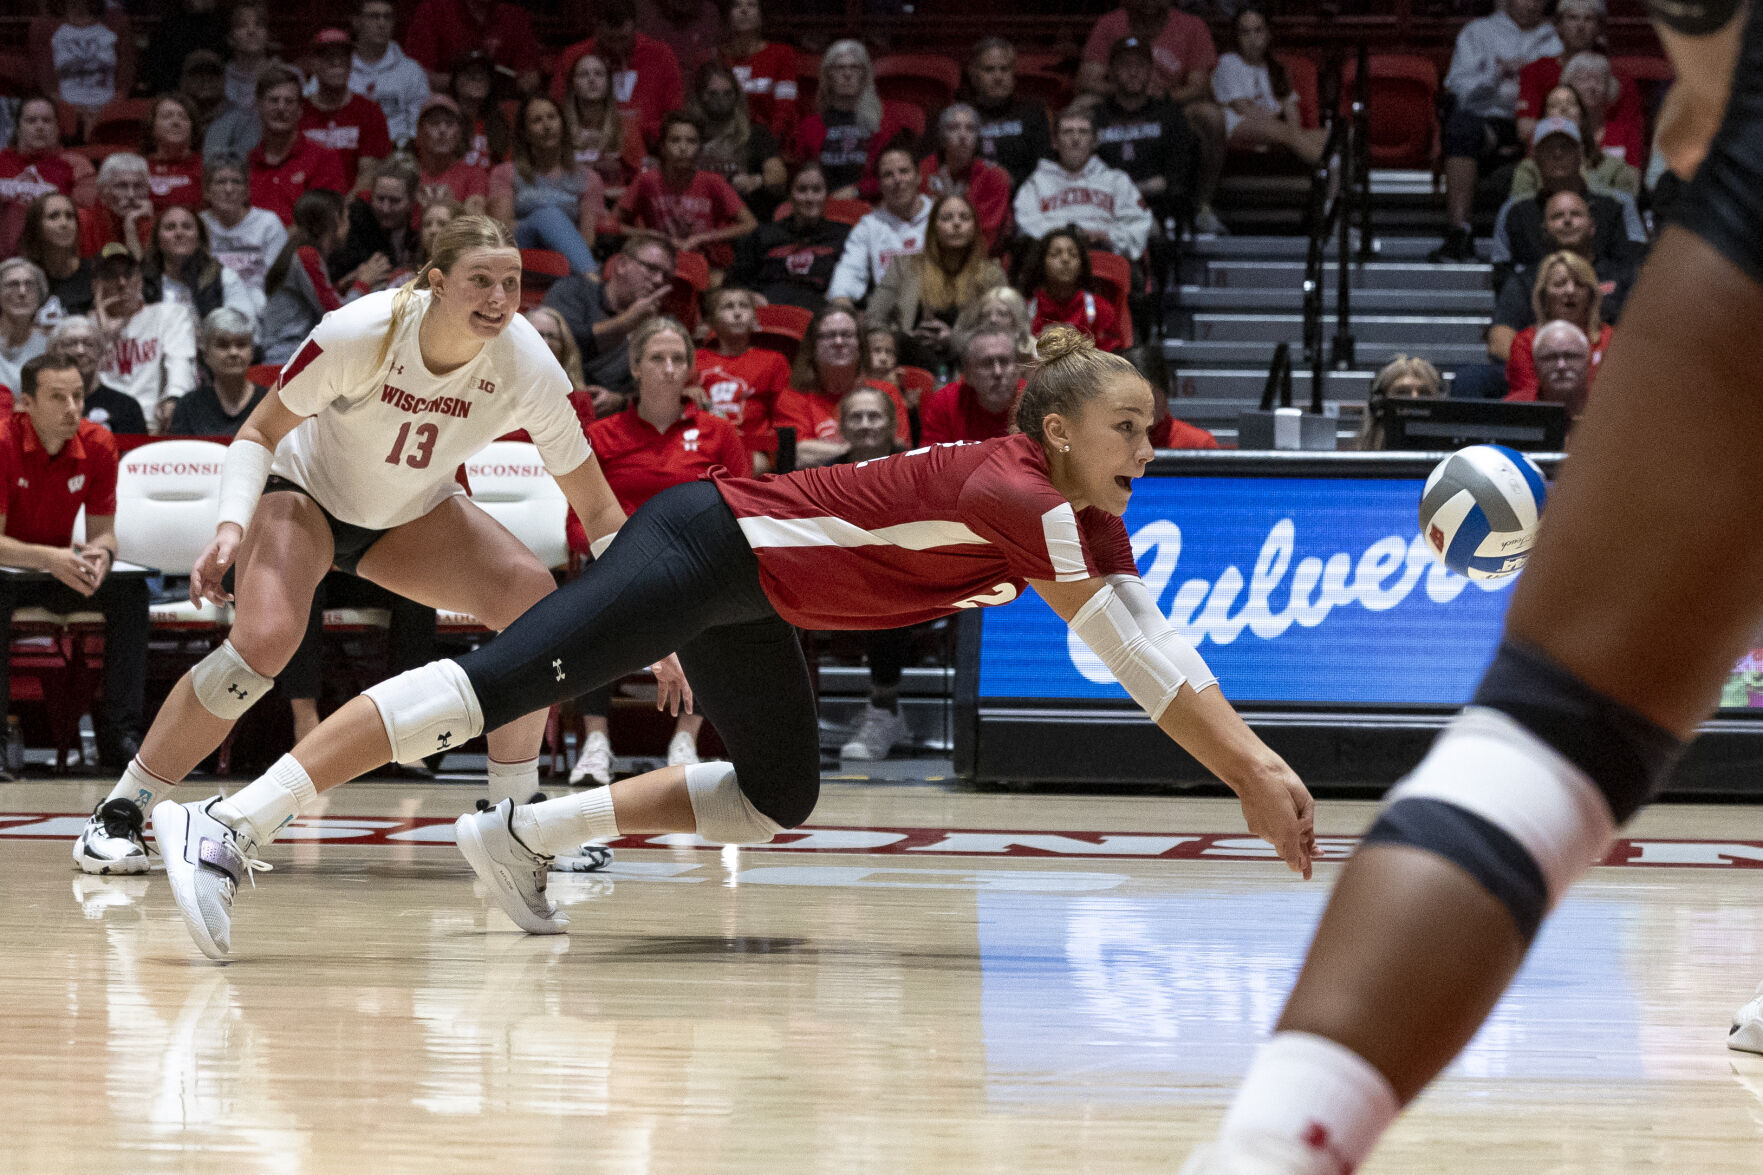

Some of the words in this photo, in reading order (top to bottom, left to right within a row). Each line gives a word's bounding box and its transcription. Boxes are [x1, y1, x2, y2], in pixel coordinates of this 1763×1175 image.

[380, 384, 473, 419] WISCONSIN
[384, 421, 440, 470] 13
[127, 463, 224, 475] WISCONSI
[1067, 517, 1522, 684] Culver
